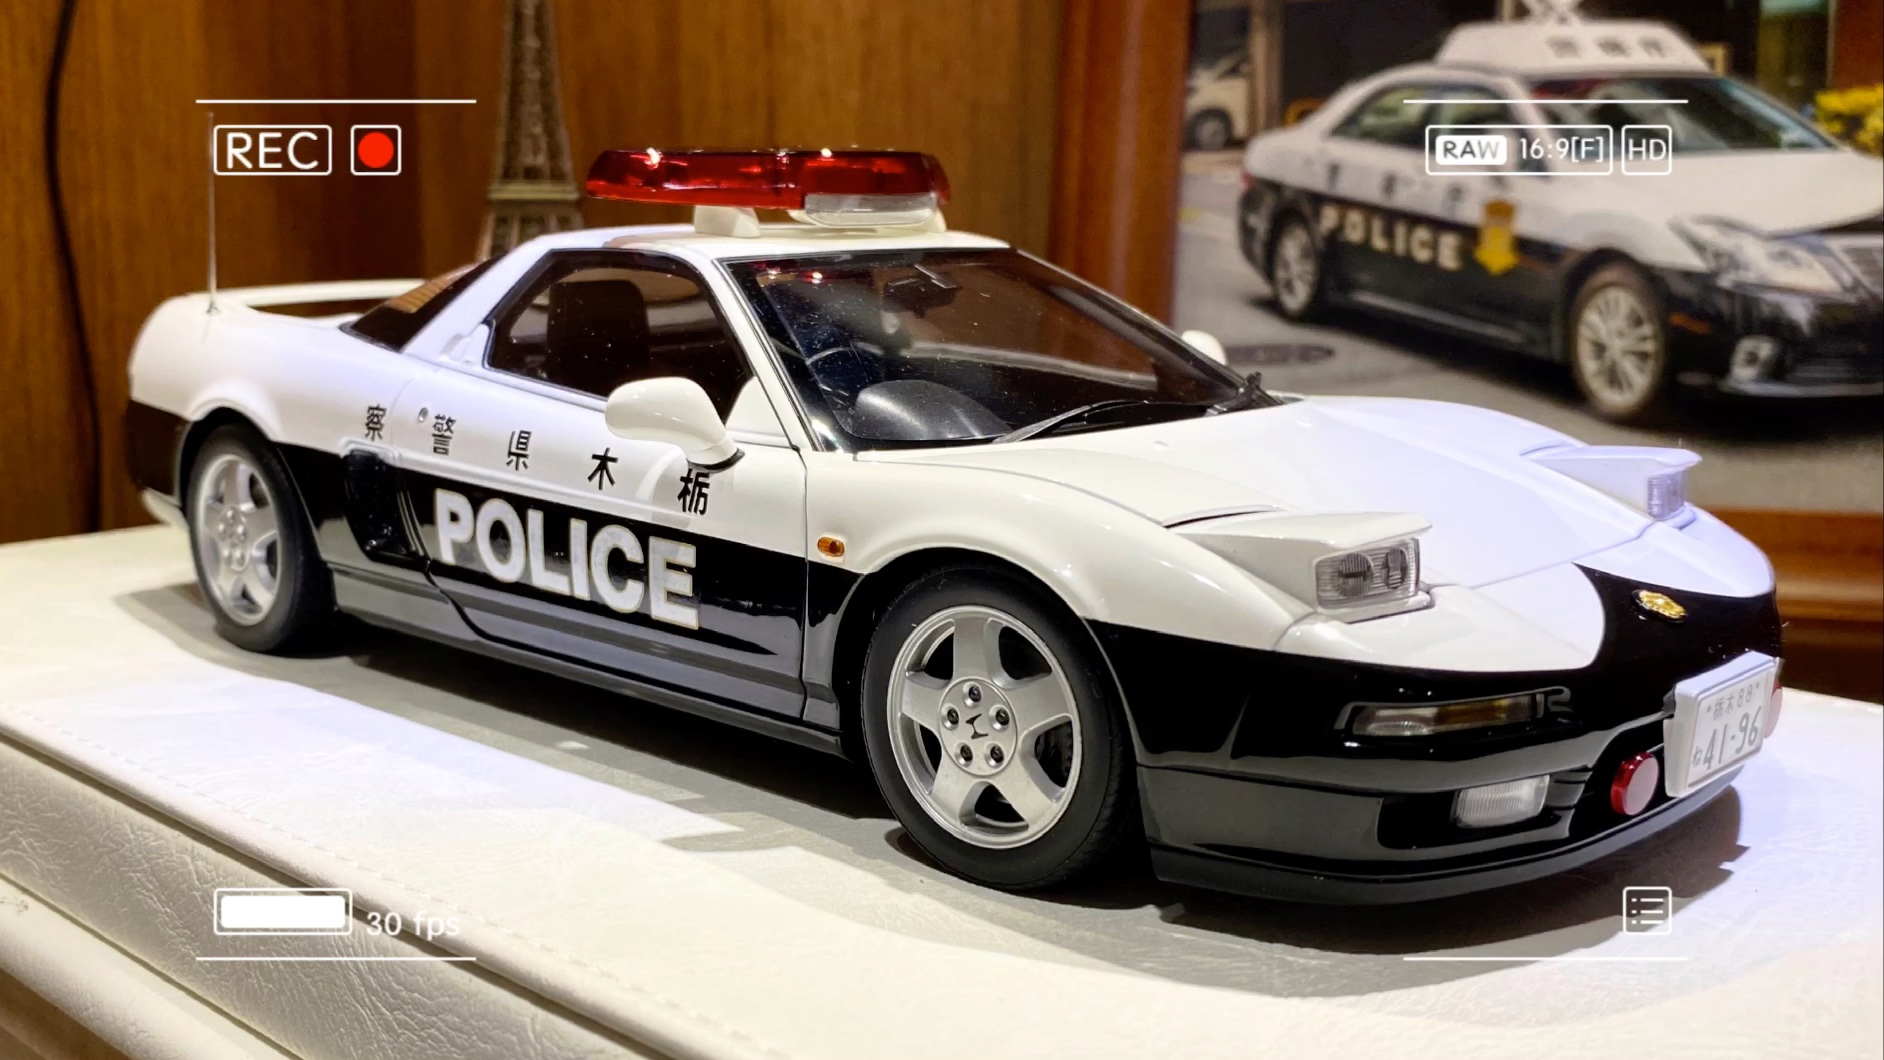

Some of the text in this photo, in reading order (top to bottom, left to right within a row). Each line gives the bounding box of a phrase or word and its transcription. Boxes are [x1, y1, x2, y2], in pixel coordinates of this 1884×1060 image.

[1320, 203, 1463, 271] POLICE
[434, 488, 699, 630] POLICE
[1703, 705, 1762, 769] 41-96
